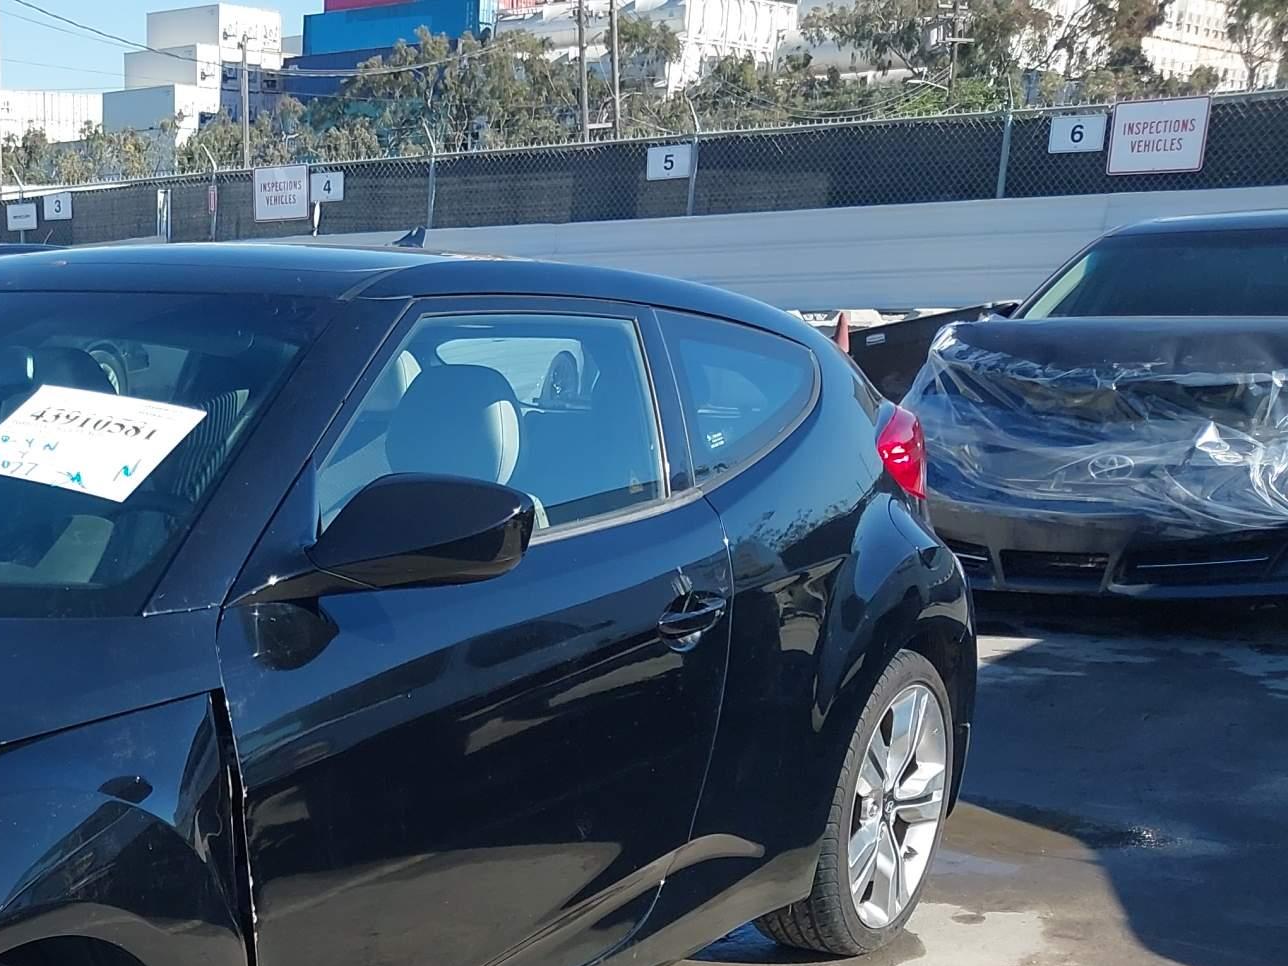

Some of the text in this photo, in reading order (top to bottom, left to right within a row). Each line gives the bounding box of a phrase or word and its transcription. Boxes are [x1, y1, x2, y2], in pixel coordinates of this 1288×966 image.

[1070, 124, 1084, 143] 6
[1122, 118, 1197, 136] INSPECTIONS
[1130, 138, 1183, 153] VEHICLES
[663, 154, 674, 171] 5
[260, 180, 302, 193] INSPECTIONS
[322, 180, 332, 195] 4
[54, 199, 62, 213] 3
[265, 195, 297, 208] VEHICLES
